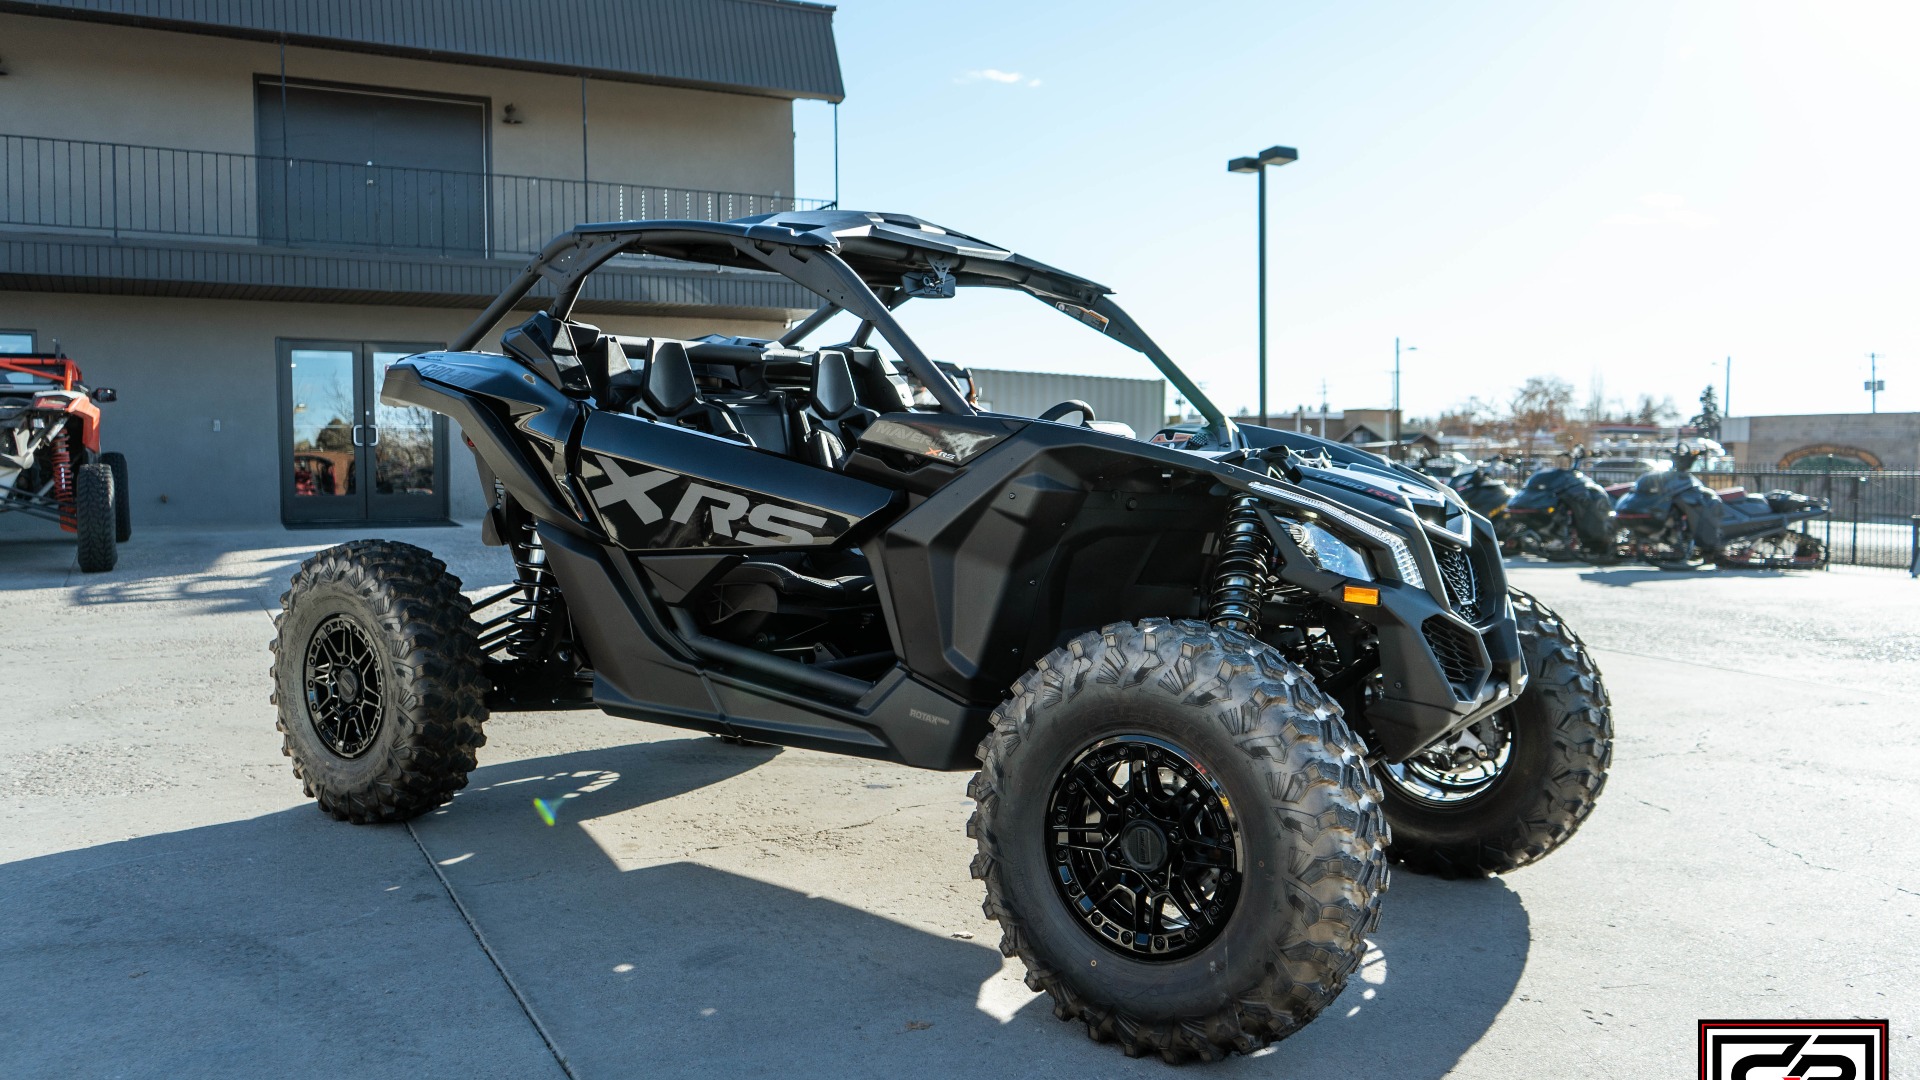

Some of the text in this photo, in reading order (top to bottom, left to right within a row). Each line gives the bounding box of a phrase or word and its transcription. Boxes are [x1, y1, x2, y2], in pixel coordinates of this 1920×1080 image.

[925, 446, 956, 460] XRS
[591, 453, 827, 546] XRS
[909, 708, 938, 725] ROTAX
